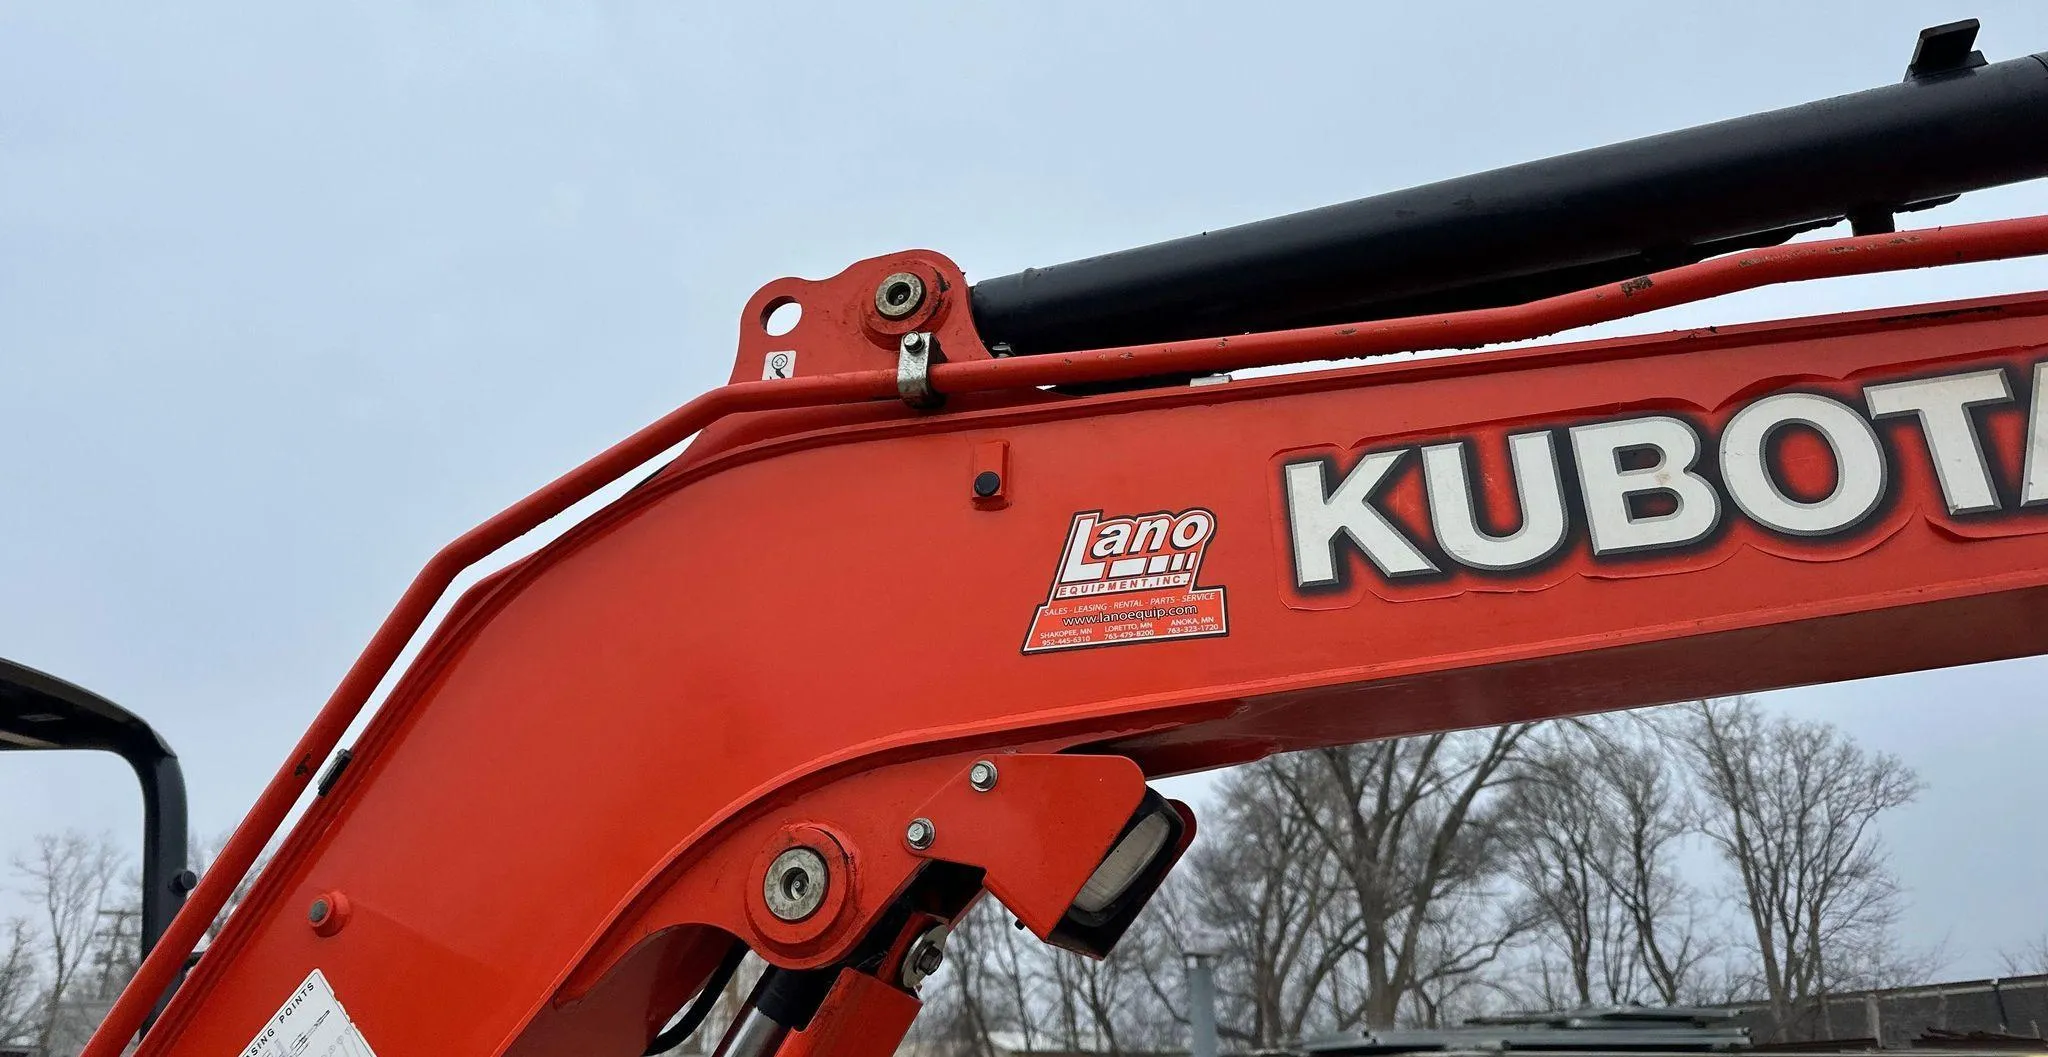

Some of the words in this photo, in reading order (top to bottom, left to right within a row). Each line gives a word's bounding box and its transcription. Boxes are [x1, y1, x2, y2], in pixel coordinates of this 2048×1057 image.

[1285, 362, 2048, 587] KUBOT
[1060, 513, 1210, 583] Lano
[1044, 607, 1068, 617] SALES
[1074, 603, 1107, 614] LEASING
[1113, 600, 1144, 610] RENTAL
[1150, 596, 1175, 605] PARTS
[1182, 592, 1215, 603] SERVICE
[1063, 605, 1198, 626] www.lanoequip.com
[1170, 617, 1200, 626] ANOKA,
[1104, 623, 1139, 633] LORETTO,
[1167, 624, 1219, 634] 763-323-1720
[1040, 629, 1079, 640] SHAKOPEE,
[1104, 629, 1154, 640] 763-479-8200
[1042, 636, 1091, 646] 952-445-6310
[246, 1028, 275, 1057] SING
[278, 982, 315, 1024] POINTS
